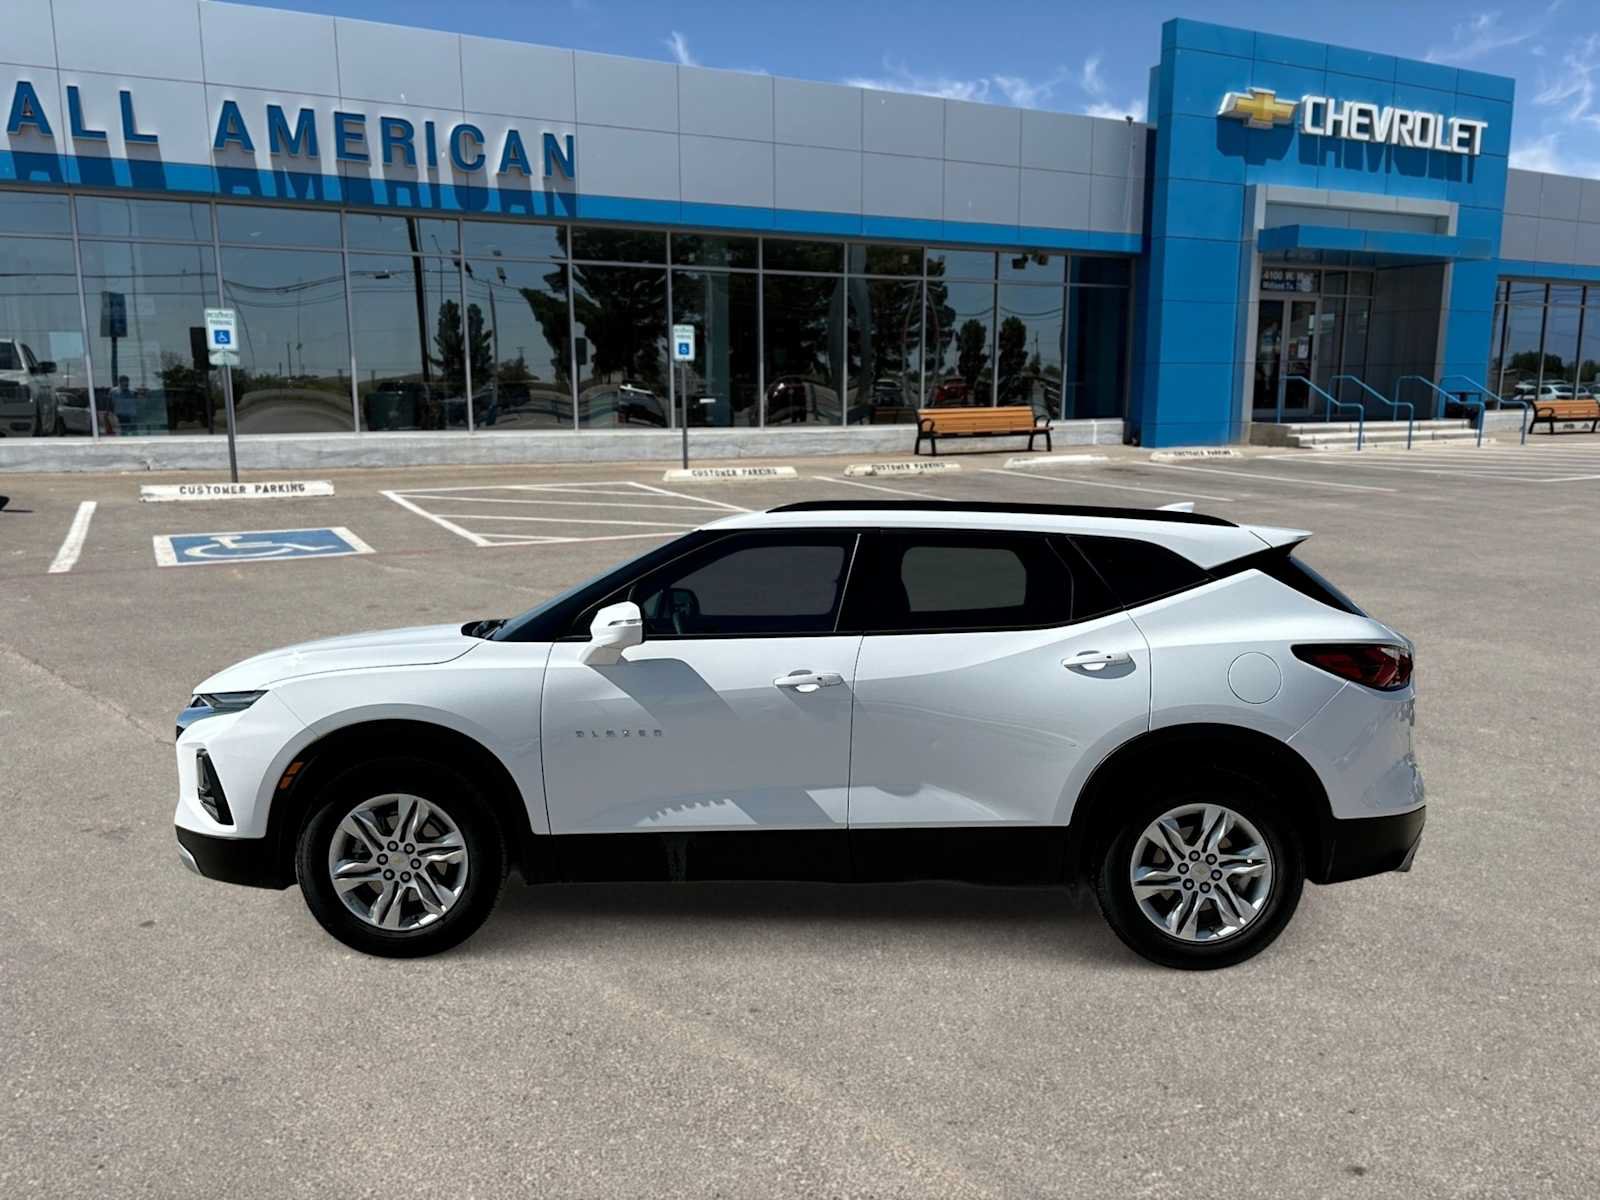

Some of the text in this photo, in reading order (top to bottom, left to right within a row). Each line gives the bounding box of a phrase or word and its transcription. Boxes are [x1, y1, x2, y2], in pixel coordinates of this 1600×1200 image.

[5, 80, 577, 181] ALL AMERICAN
[1301, 94, 1488, 156] CHEVROLET
[179, 482, 306, 496] CUSTOMER PARKING
[691, 468, 778, 478] CUSTOMER PARKING
